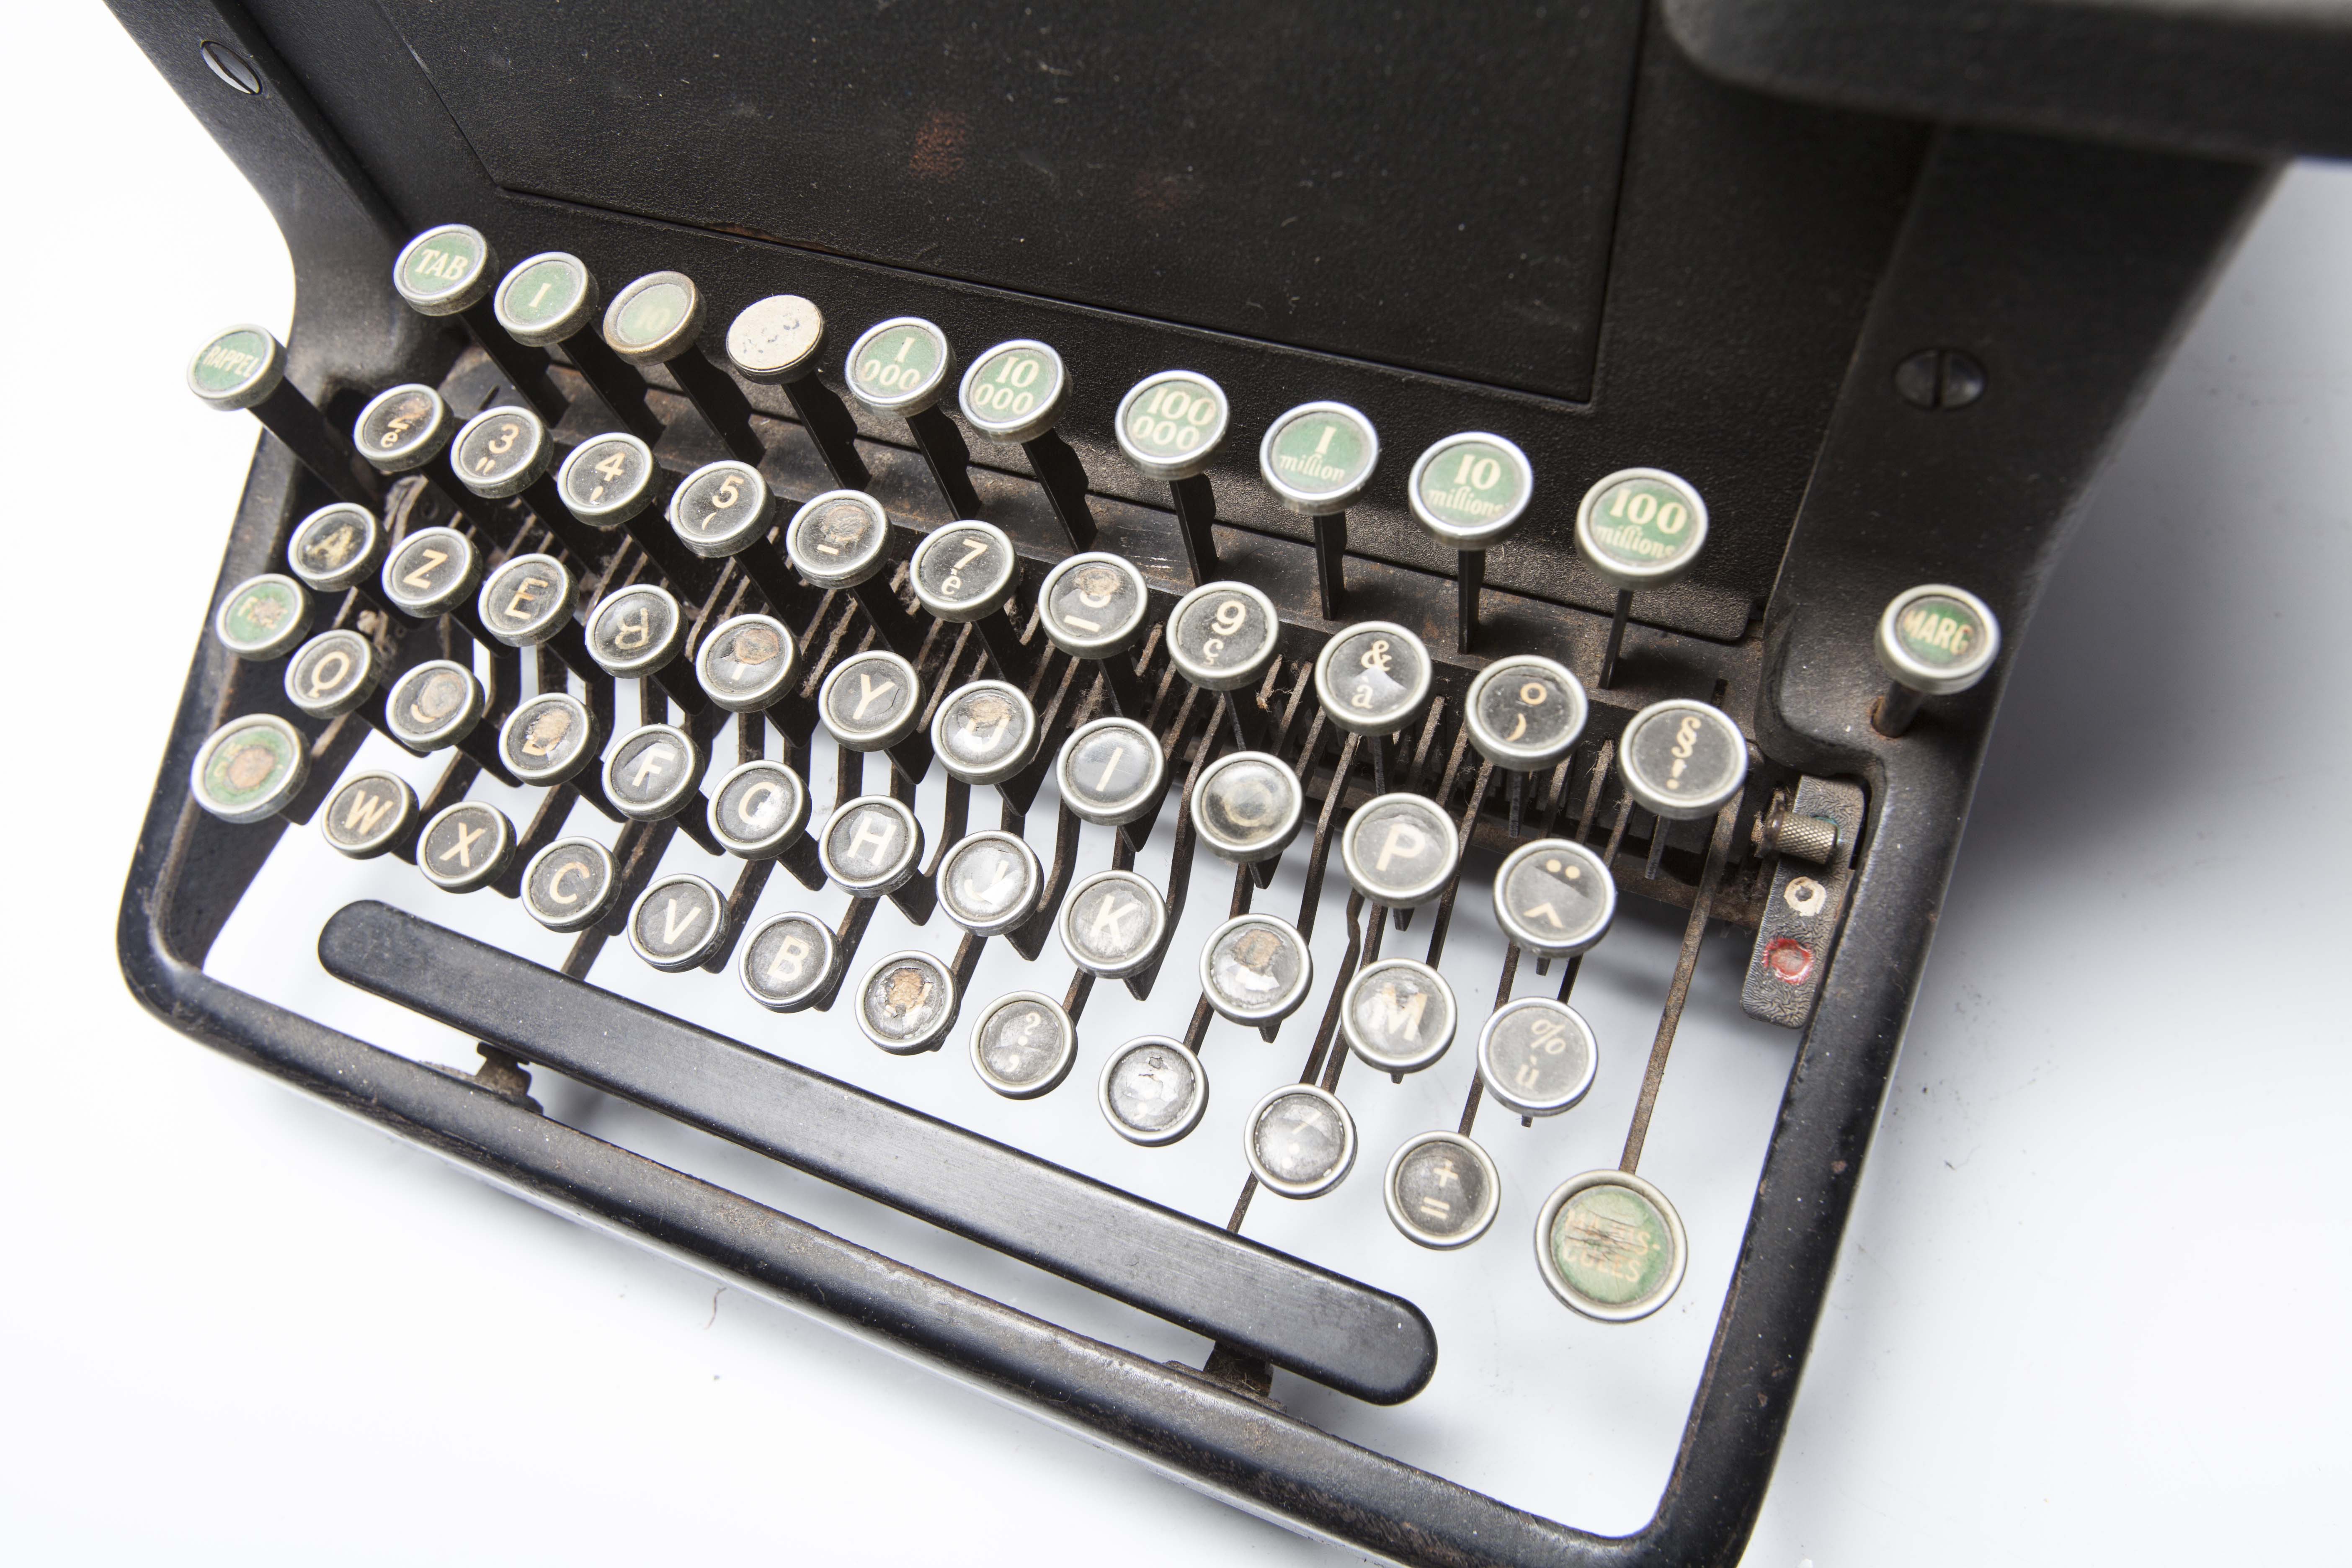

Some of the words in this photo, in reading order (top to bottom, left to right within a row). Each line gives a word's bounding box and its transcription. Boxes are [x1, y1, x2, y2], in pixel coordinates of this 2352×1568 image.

[415, 249, 468, 281] TAB
[203, 346, 260, 378] RAPPEL
[862, 359, 921, 391] 000
[996, 356, 1039, 388] 10
[974, 384, 1033, 415] 000
[1147, 387, 1215, 426] 100
[380, 428, 401, 448] é
[489, 423, 519, 454] 3
[1133, 418, 1200, 450] 000
[595, 452, 626, 482] 4
[1279, 454, 1345, 482] million
[1454, 454, 1501, 490] 10
[712, 475, 744, 508] 5
[1427, 486, 1504, 517] millions
[1609, 488, 1688, 534] 100
[954, 539, 988, 570] 7
[1595, 524, 1675, 559] millions
[402, 548, 448, 590] Z
[504, 576, 549, 620] E
[1211, 600, 1246, 635] 9
[1202, 638, 1224, 665] ç
[1360, 640, 1393, 672] &
[308, 651, 351, 698] Q
[1351, 675, 1374, 709] à
[852, 673, 895, 720] Y
[632, 747, 677, 787] F
[345, 789, 394, 836] W
[738, 781, 781, 828] G
[439, 821, 486, 868] X
[847, 817, 897, 867] H
[1375, 822, 1426, 872] P
[549, 861, 590, 905] C
[964, 859, 1009, 903] J
[663, 898, 702, 945] V
[1089, 894, 1138, 947] K
[767, 935, 810, 982] B
[1019, 1012, 1042, 1047] ?
[1367, 982, 1428, 1042] M
[1531, 1019, 1567, 1055] %
[1433, 1159, 1459, 1187] +
